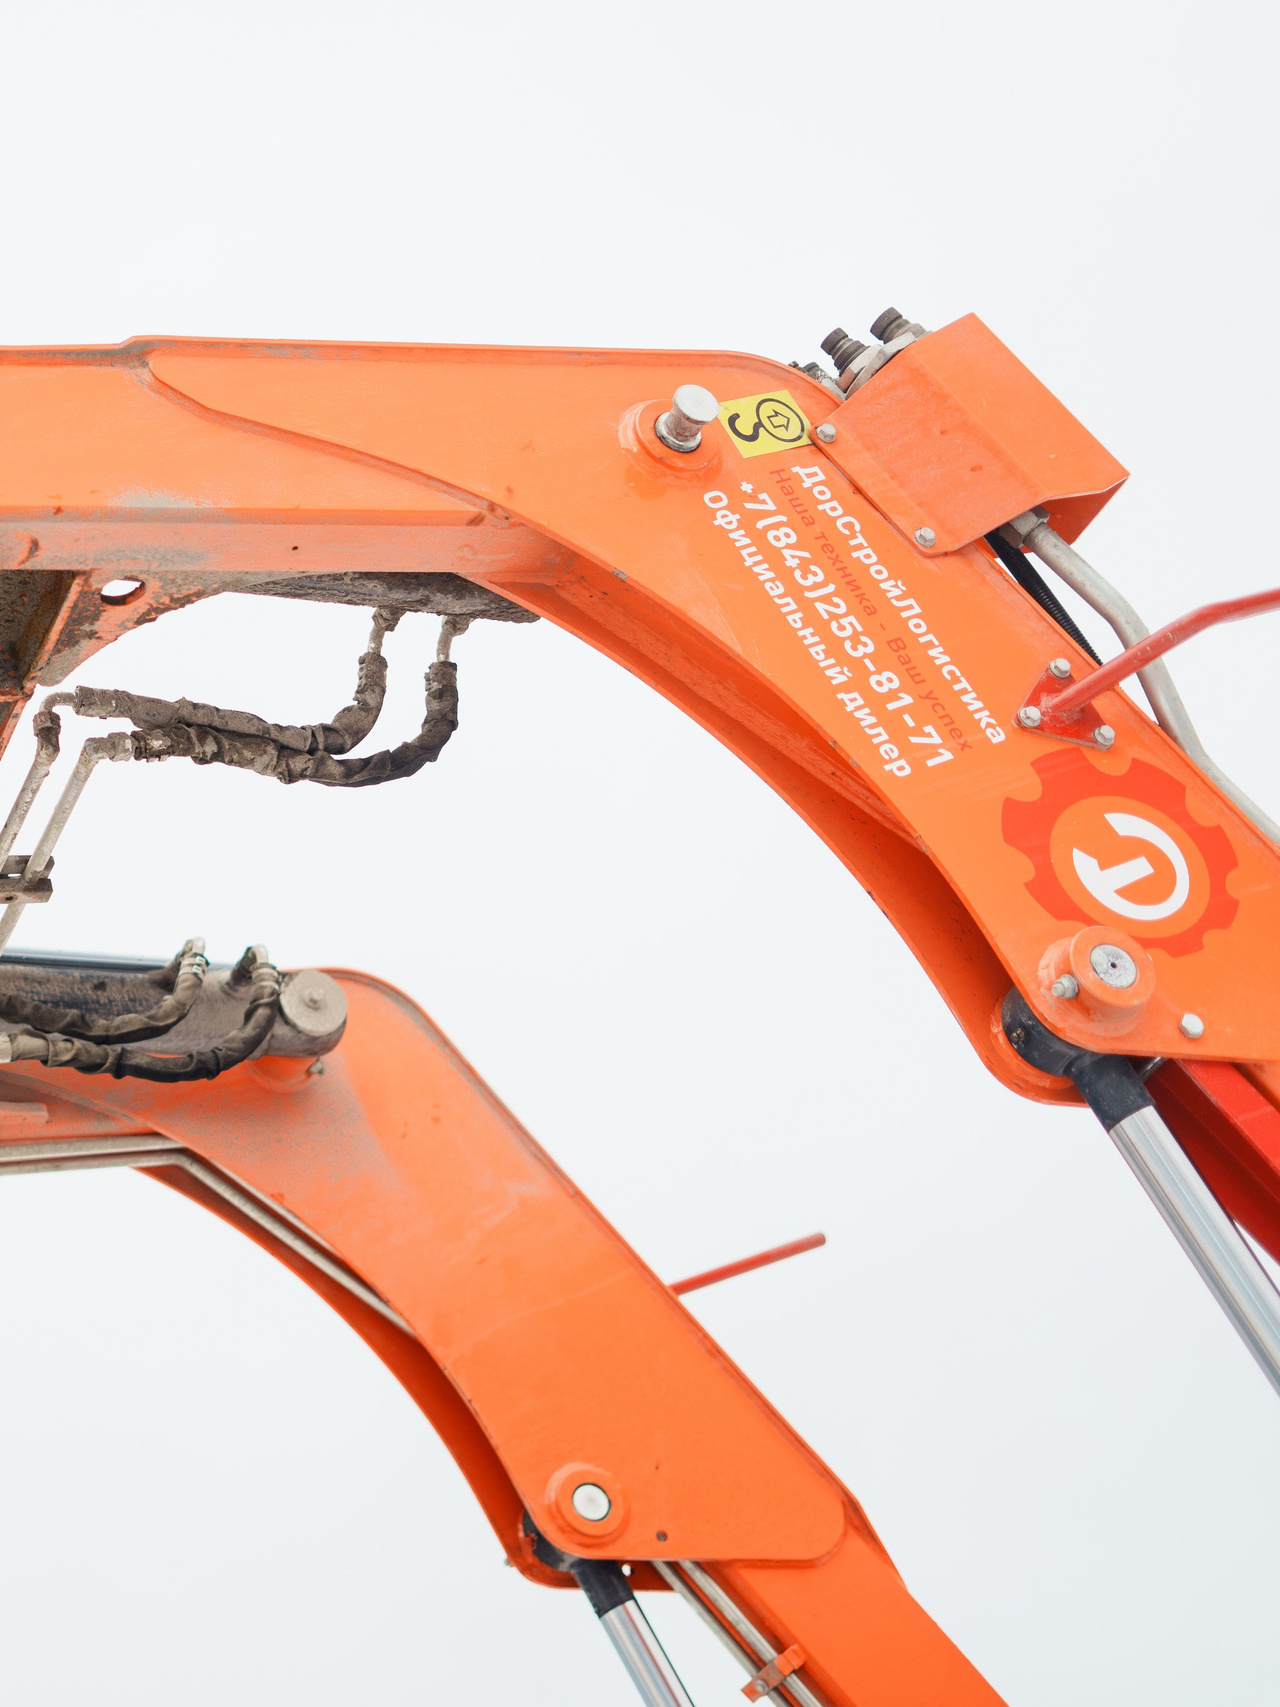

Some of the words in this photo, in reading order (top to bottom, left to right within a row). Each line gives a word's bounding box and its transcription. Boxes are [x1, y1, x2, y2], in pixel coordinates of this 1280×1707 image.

[703, 490, 853, 685] Официальный
[836, 691, 912, 777] дилер
[740, 481, 955, 767] +7(843)253-81-71
[769, 468, 816, 527] Наша
[814, 531, 878, 616] техника
[886, 636, 926, 685] Ваш
[918, 689, 973, 752] успех
[791, 466, 1006, 744] ДорСтройЛогистика
